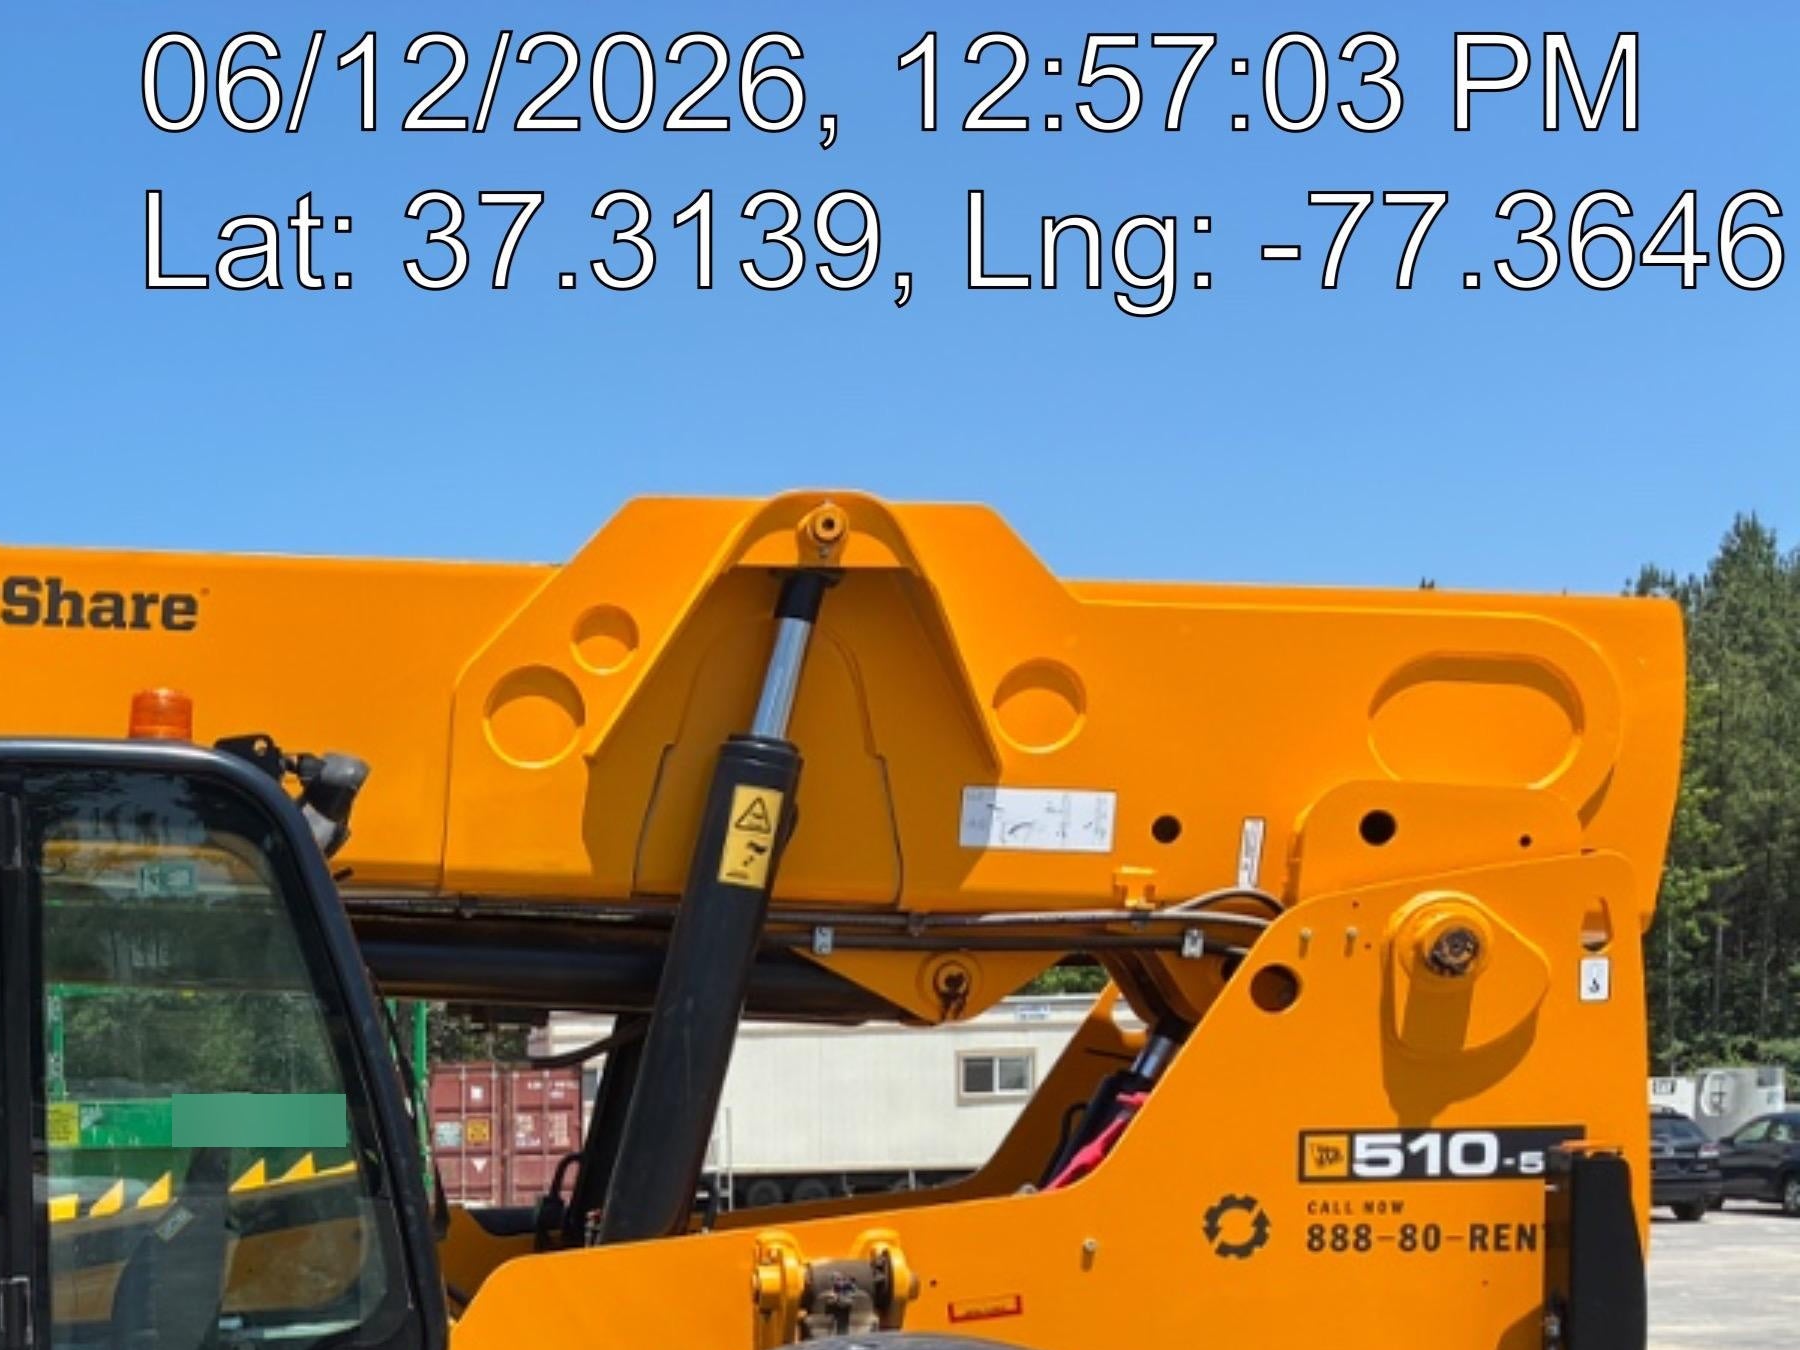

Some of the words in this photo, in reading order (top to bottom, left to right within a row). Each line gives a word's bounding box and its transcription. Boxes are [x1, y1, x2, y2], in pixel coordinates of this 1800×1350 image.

[1352, 1131, 1544, 1177] 510-5
[1307, 1200, 1352, 1215] CALL
[1363, 1200, 1405, 1215] NOW
[1306, 1222, 1544, 1252] 888-80-REN
